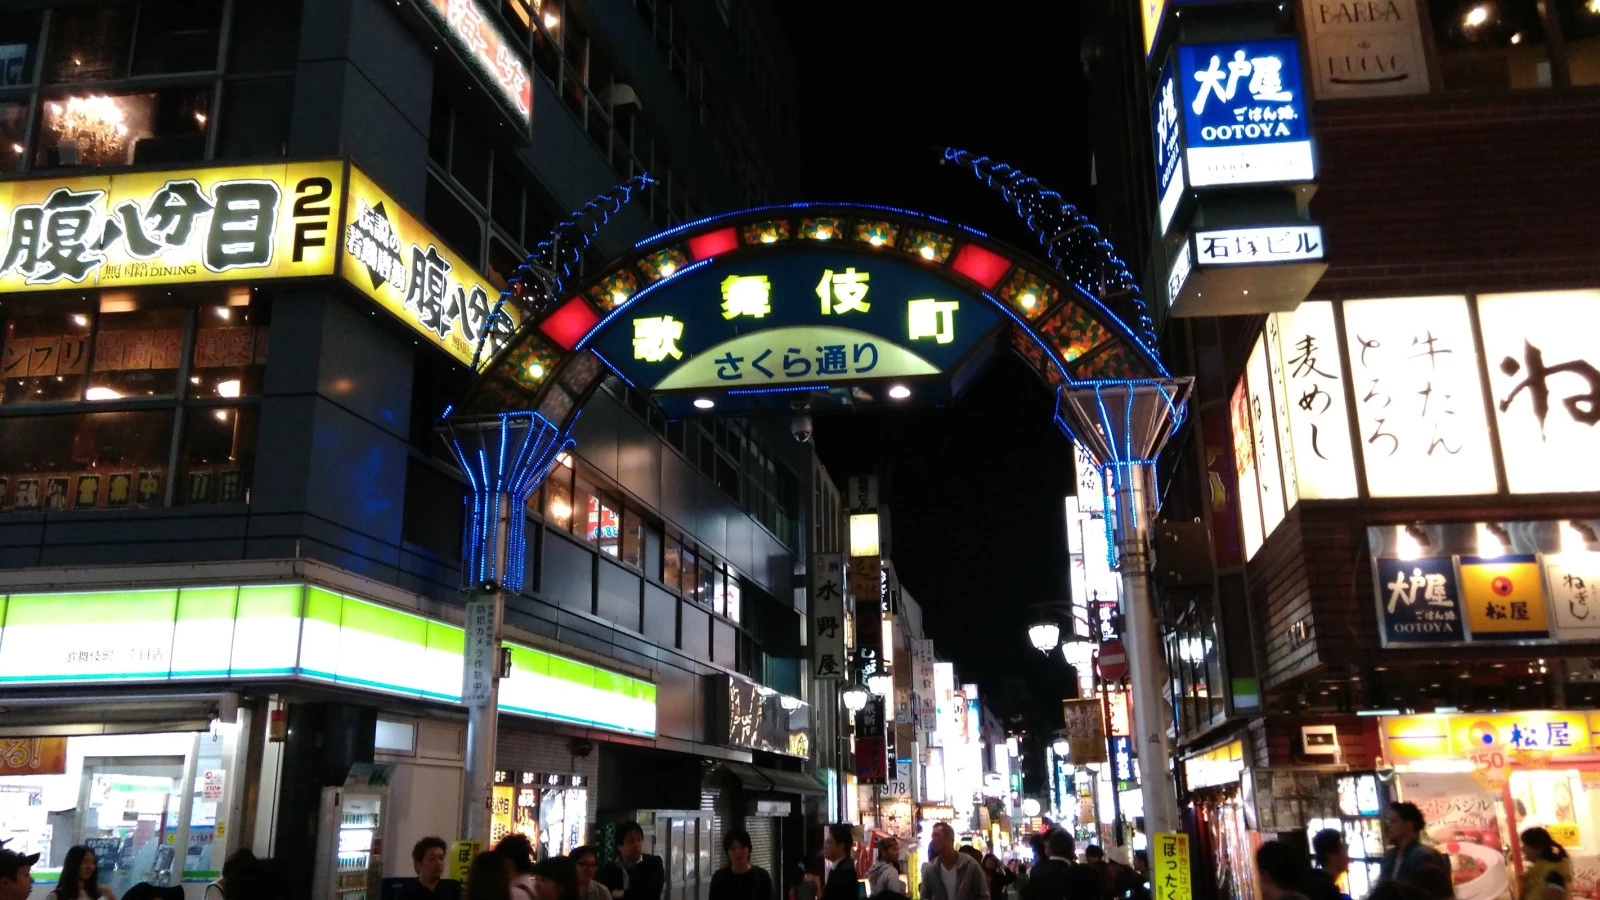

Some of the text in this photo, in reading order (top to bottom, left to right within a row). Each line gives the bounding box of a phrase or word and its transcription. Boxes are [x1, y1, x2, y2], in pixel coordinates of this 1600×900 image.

[1320, 0, 1401, 24] BARBA
[1191, 50, 1293, 115] 大戸屋
[1201, 122, 1291, 140] OOTOYA
[1, 178, 282, 285] 腹八分目
[291, 177, 334, 263] 2F
[1203, 232, 1319, 259] 石塚ビル
[150, 265, 197, 277] DINING
[632, 267, 960, 362] 歌舞伎町
[714, 342, 879, 380] さくら通り
[1288, 334, 1338, 460] 麦めし
[1356, 333, 1399, 457] とろろ
[1408, 330, 1464, 457] 牛たん
[1387, 567, 1454, 613] 大戸屋
[1486, 601, 1531, 621] 松屋
[1563, 573, 1590, 621] ねぎし
[816, 580, 841, 676] 水野屋
[1395, 622, 1454, 633] OOTOYA
[0, 737, 41, 769] る!
[1510, 721, 1572, 747] 松屋
[494, 771, 506, 783] 2F
